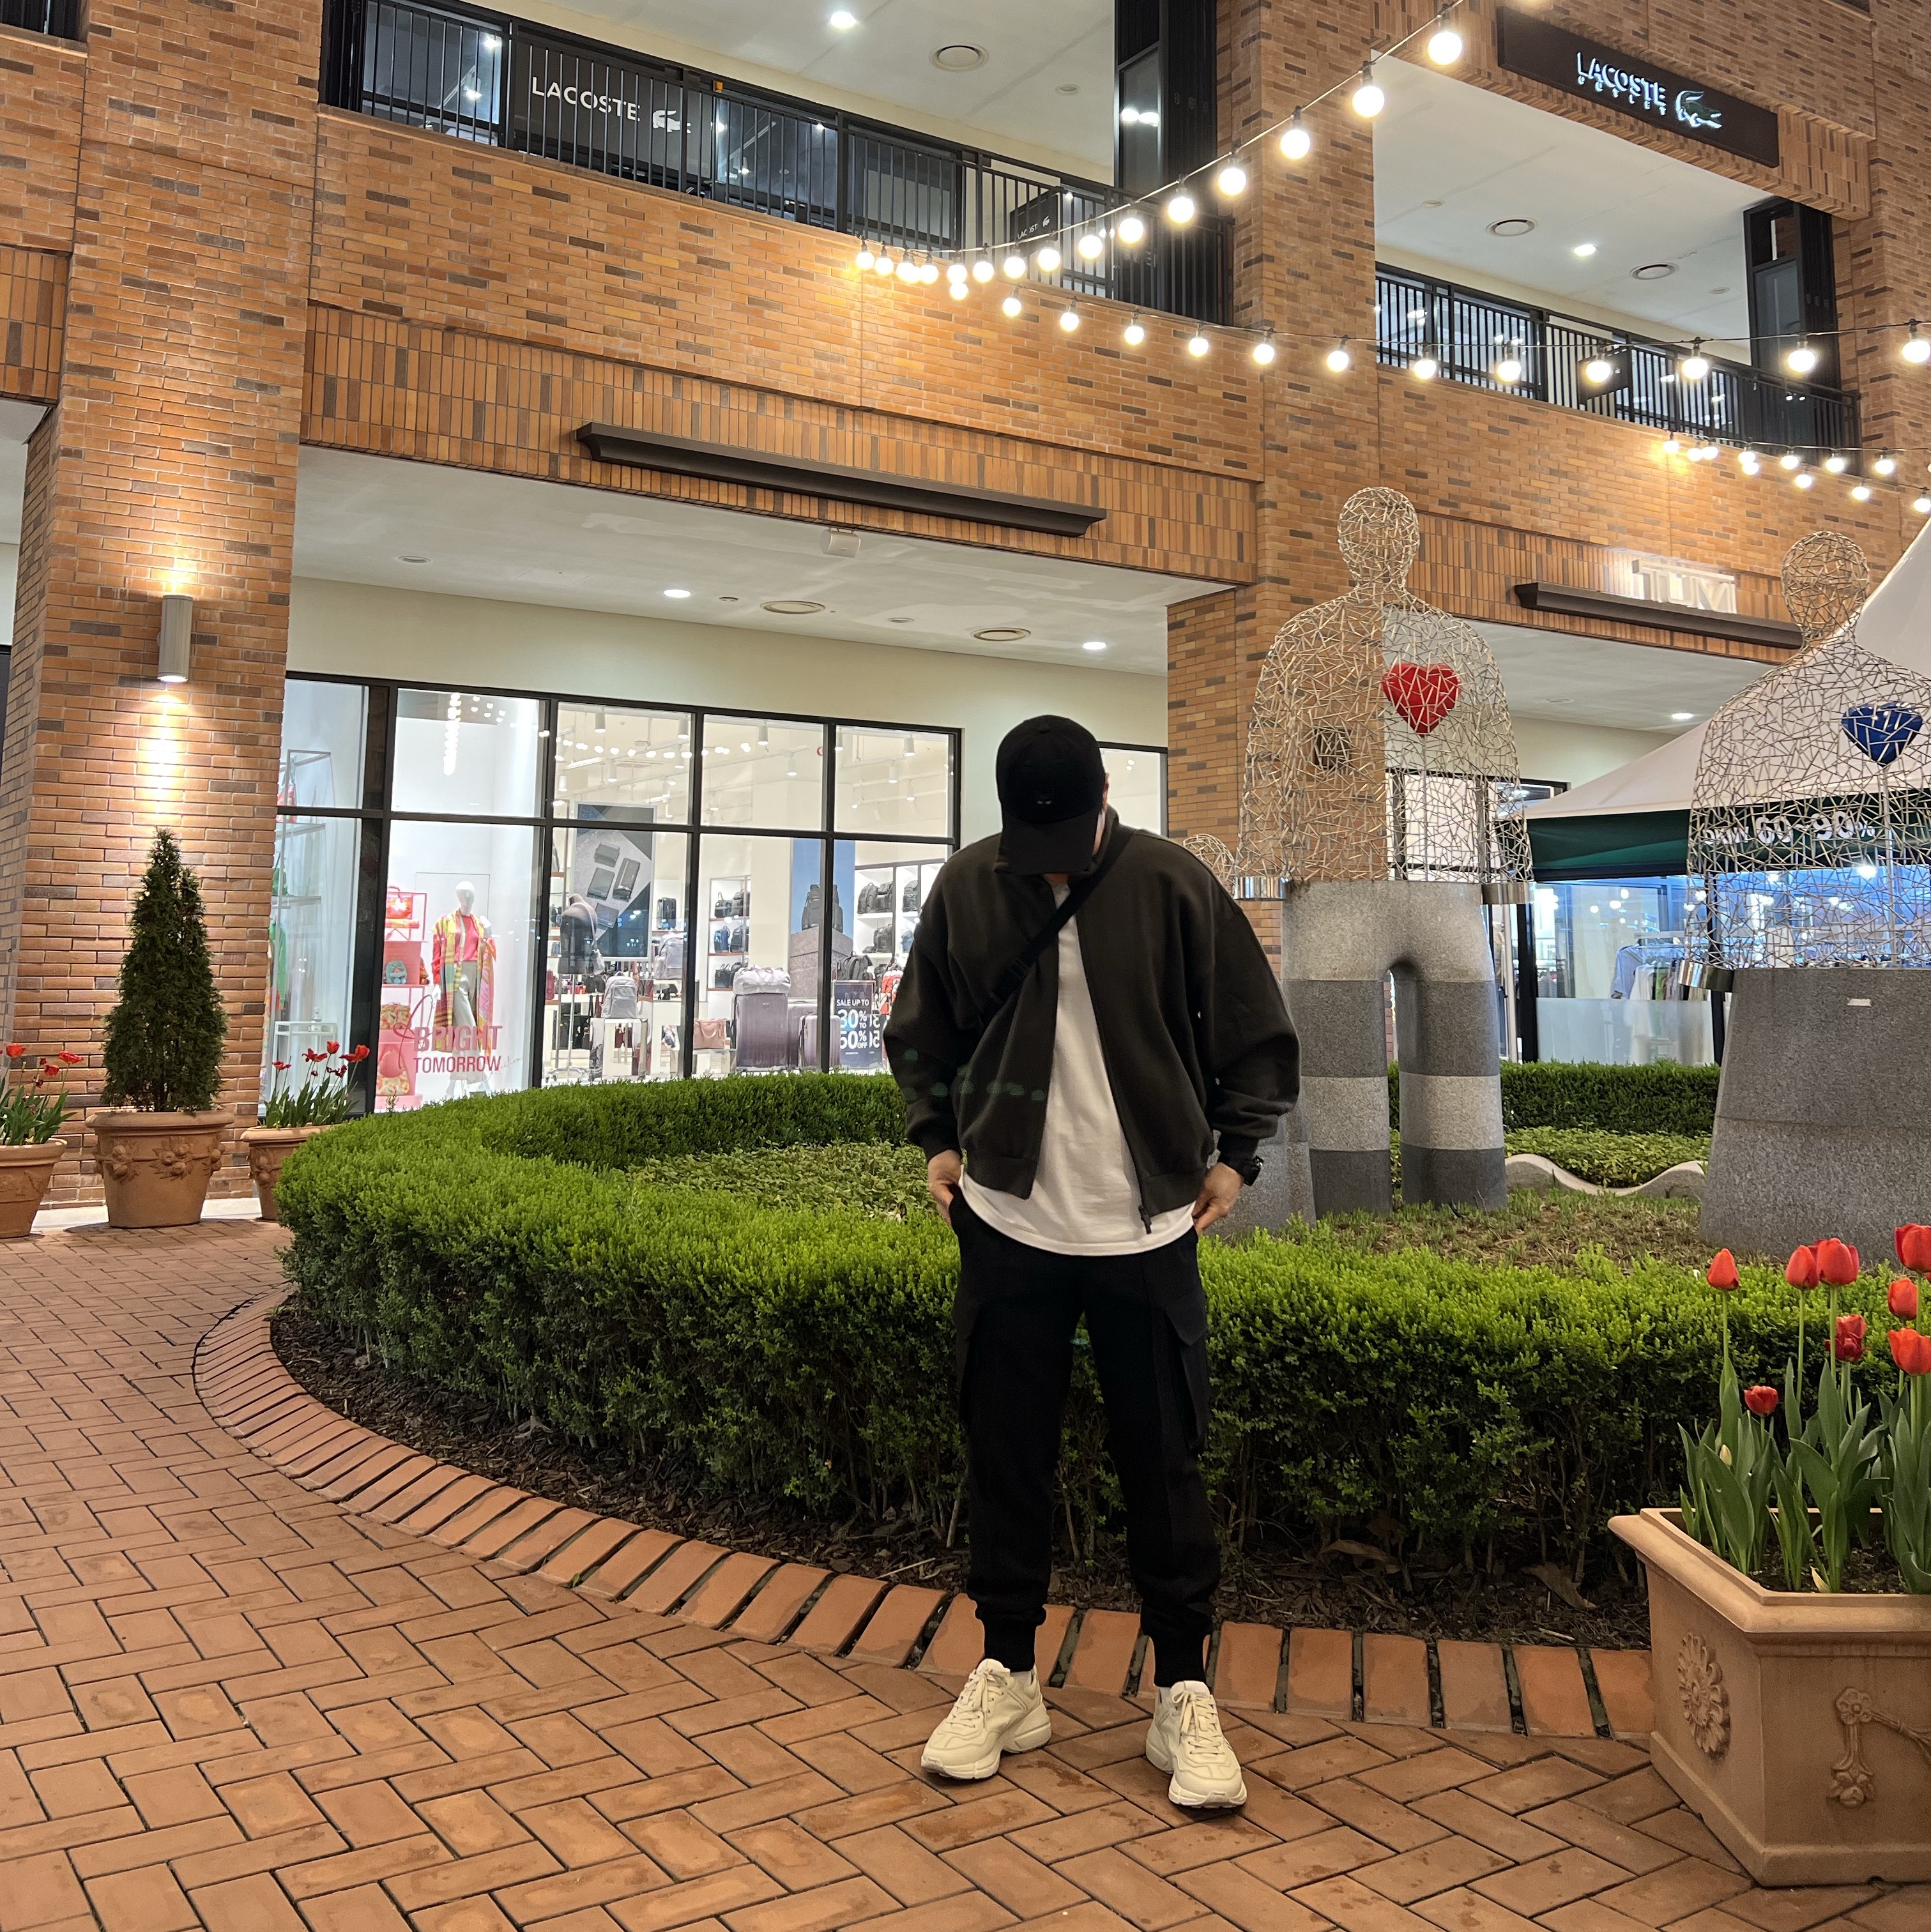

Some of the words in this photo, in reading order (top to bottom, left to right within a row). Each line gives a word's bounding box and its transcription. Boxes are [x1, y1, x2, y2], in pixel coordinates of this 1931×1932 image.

[1576, 52, 1667, 107] LACOSTE
[531, 76, 641, 122] LACOSTE
[413, 1025, 503, 1051] BRIGHT
[413, 1056, 502, 1074] TOMORROW
